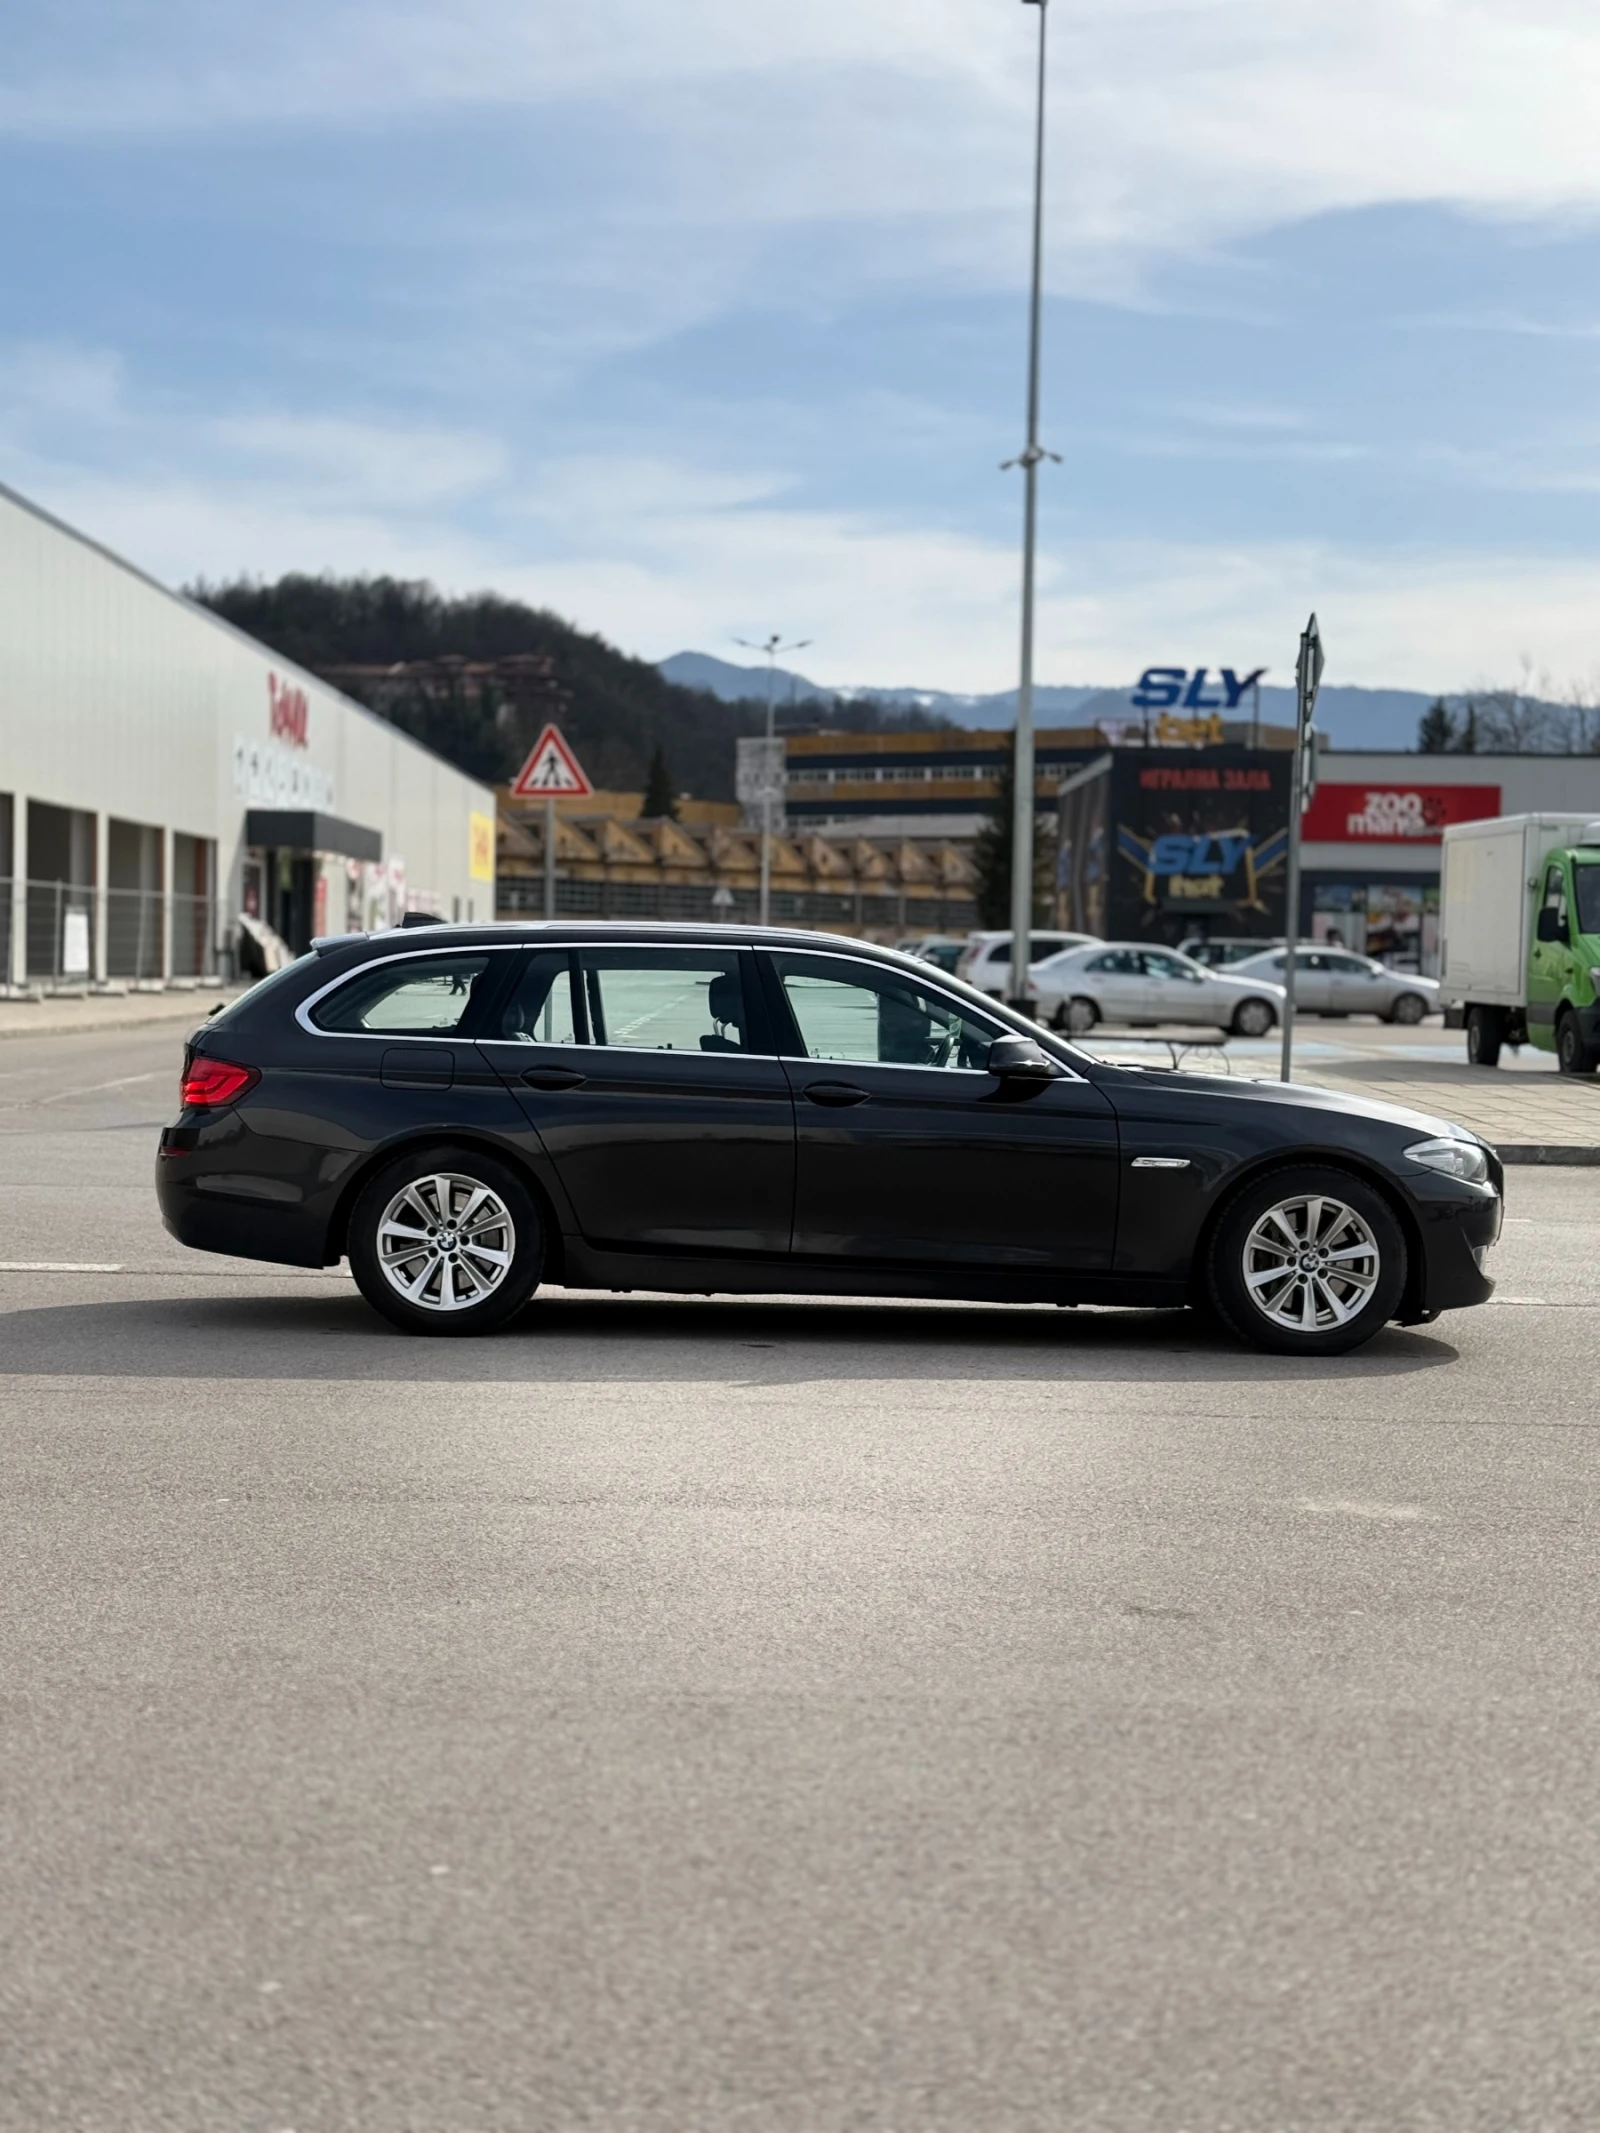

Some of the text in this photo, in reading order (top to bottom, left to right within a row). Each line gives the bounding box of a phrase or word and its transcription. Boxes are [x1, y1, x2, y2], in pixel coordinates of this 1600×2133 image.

[1131, 667, 1268, 708] SLY
[1157, 711, 1224, 744] bet
[1223, 768, 1271, 791] ЗАЛА
[1148, 833, 1257, 876] SLY
